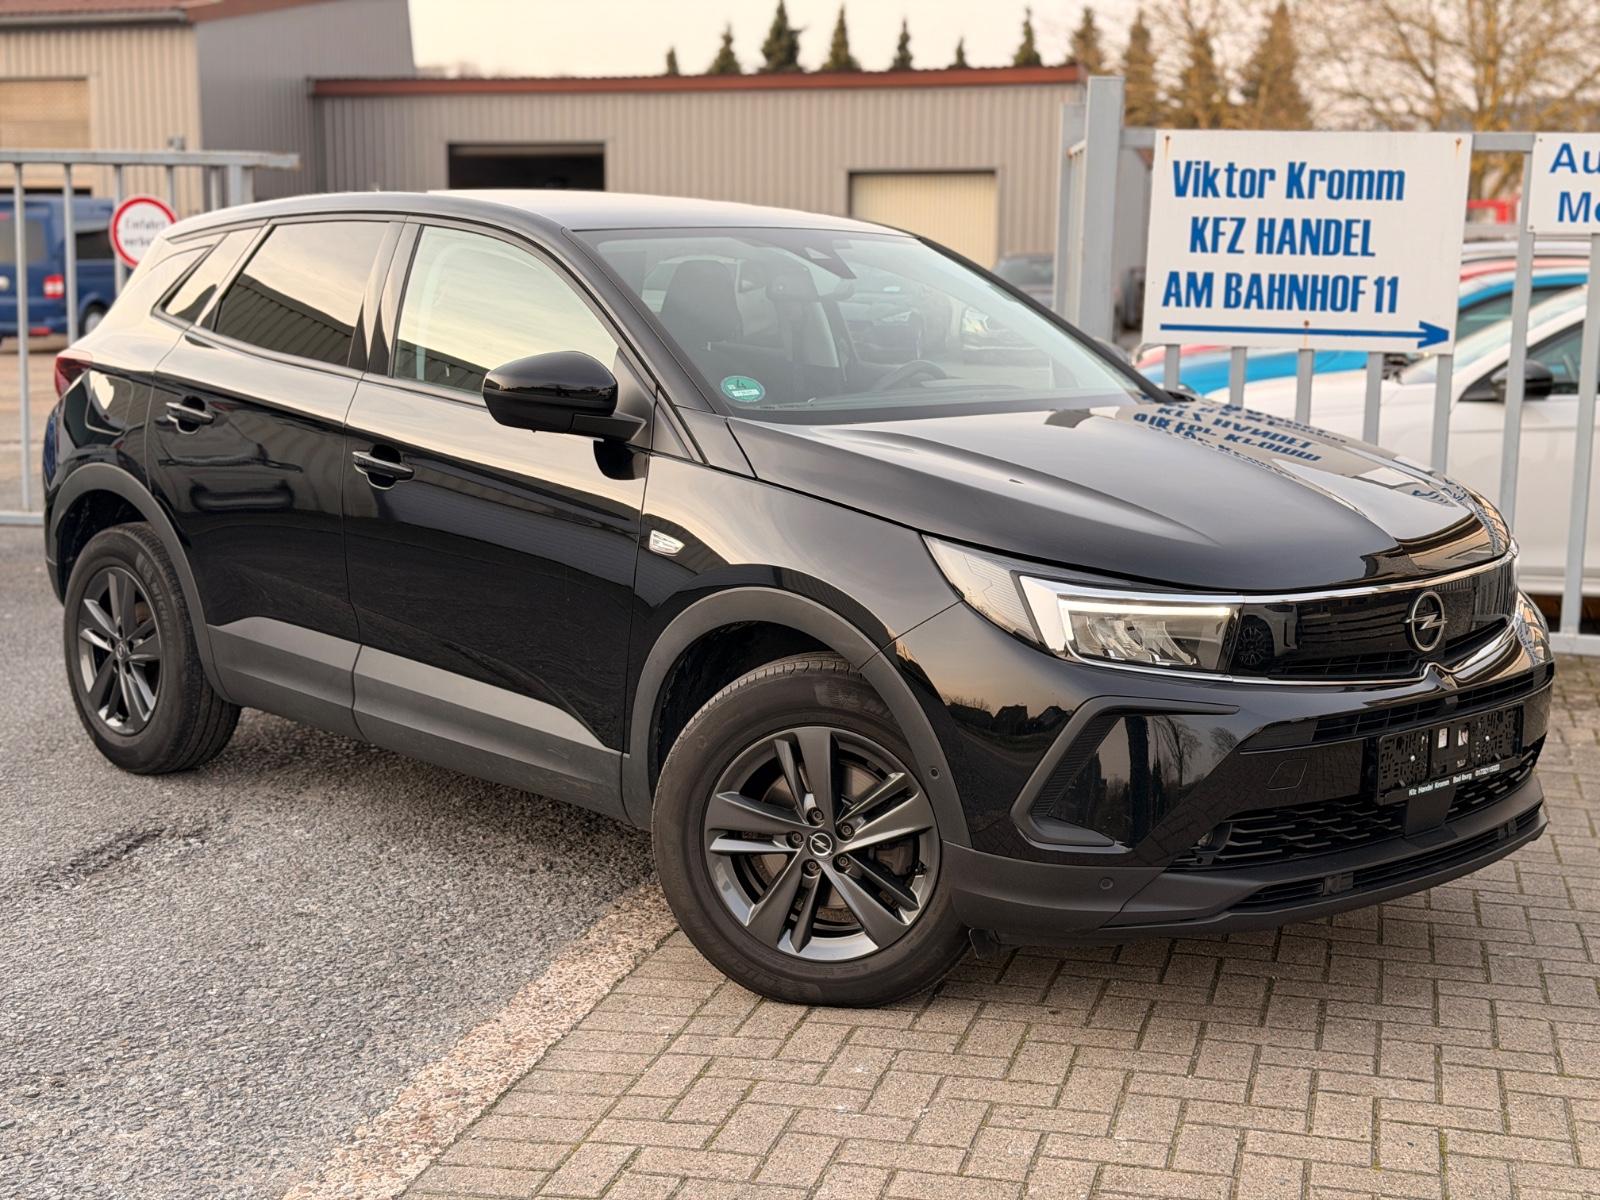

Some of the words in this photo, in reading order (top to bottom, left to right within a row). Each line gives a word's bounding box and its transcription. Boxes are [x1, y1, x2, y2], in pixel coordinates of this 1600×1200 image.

[1172, 159, 1276, 200] Viktor
[1285, 161, 1406, 202] Kromm
[1188, 216, 1246, 255] KFZ
[1255, 217, 1375, 257] HANDEL
[1162, 271, 1215, 309] AM
[1223, 272, 1367, 313] BAHNHOF
[1374, 276, 1400, 314] 11
